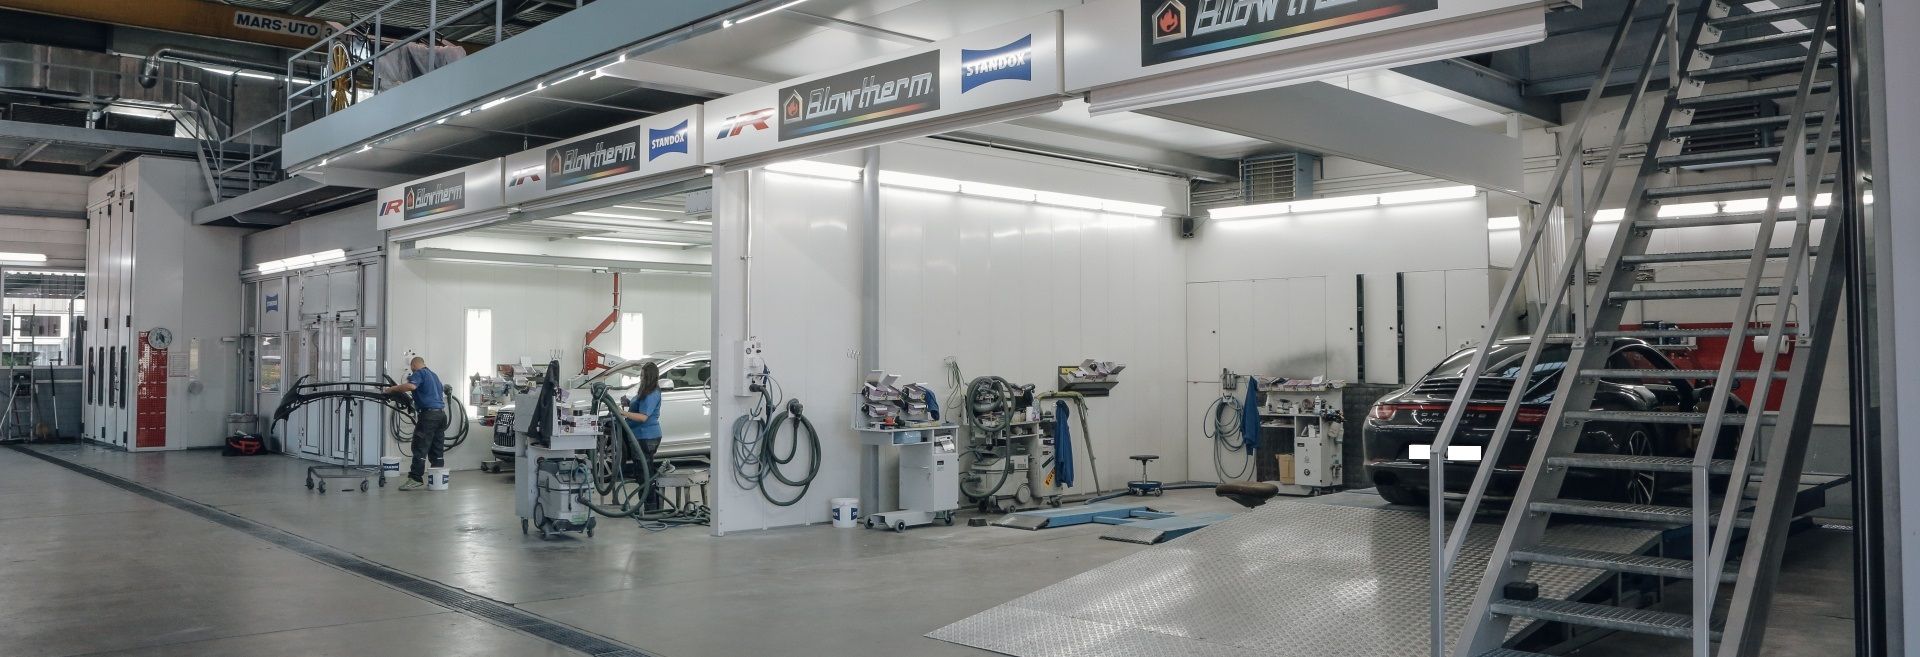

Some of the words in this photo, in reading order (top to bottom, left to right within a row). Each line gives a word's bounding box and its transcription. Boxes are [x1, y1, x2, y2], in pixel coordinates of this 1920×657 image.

[236, 14, 318, 36] MARS-UTO
[965, 51, 1026, 77] STANDOX
[805, 72, 933, 120] Blowtherm
[652, 131, 685, 150] STANDOX
[563, 142, 636, 172] Blowtherm
[415, 184, 463, 207] Blowtherm
[379, 199, 403, 216] IR
